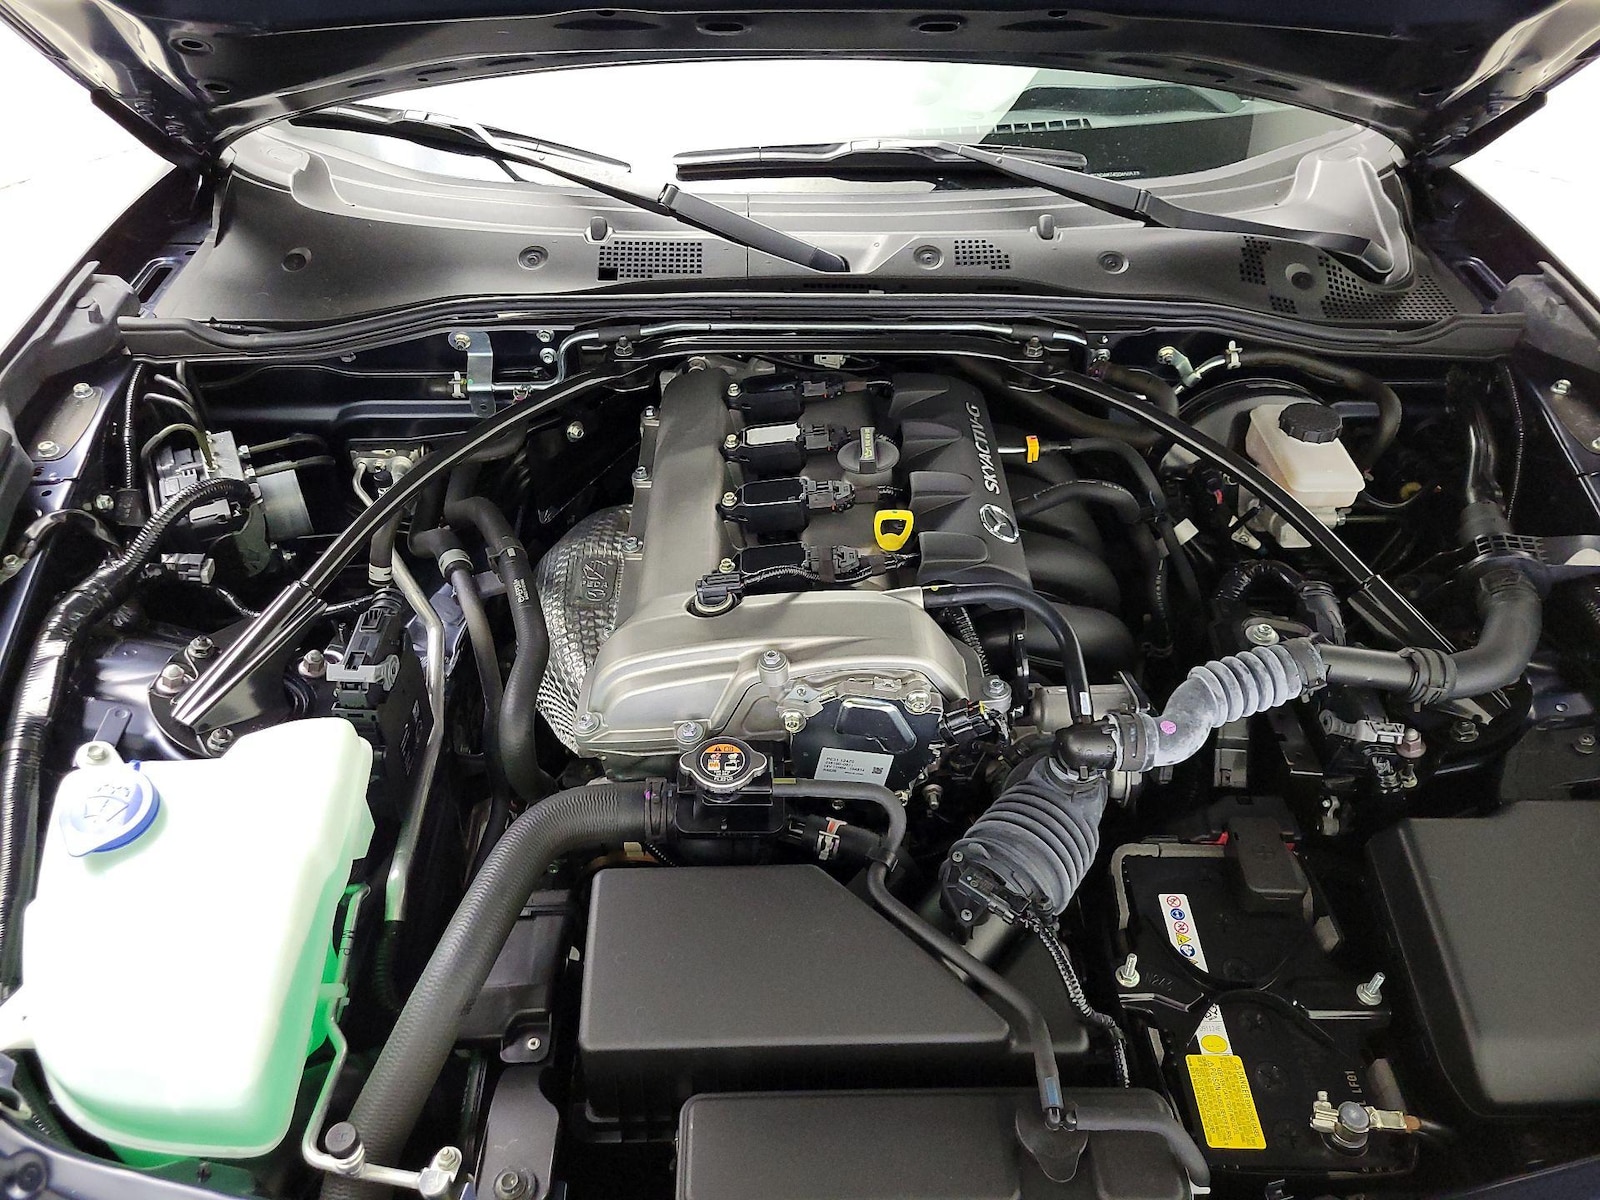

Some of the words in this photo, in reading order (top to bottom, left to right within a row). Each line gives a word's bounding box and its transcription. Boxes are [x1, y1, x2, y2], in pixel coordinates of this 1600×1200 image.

[965, 401, 1001, 495] SKYACTIV-G
[1210, 1068, 1221, 1091] POISON
[1238, 1071, 1251, 1099] DANGER
[1344, 1070, 1363, 1094] LF01
